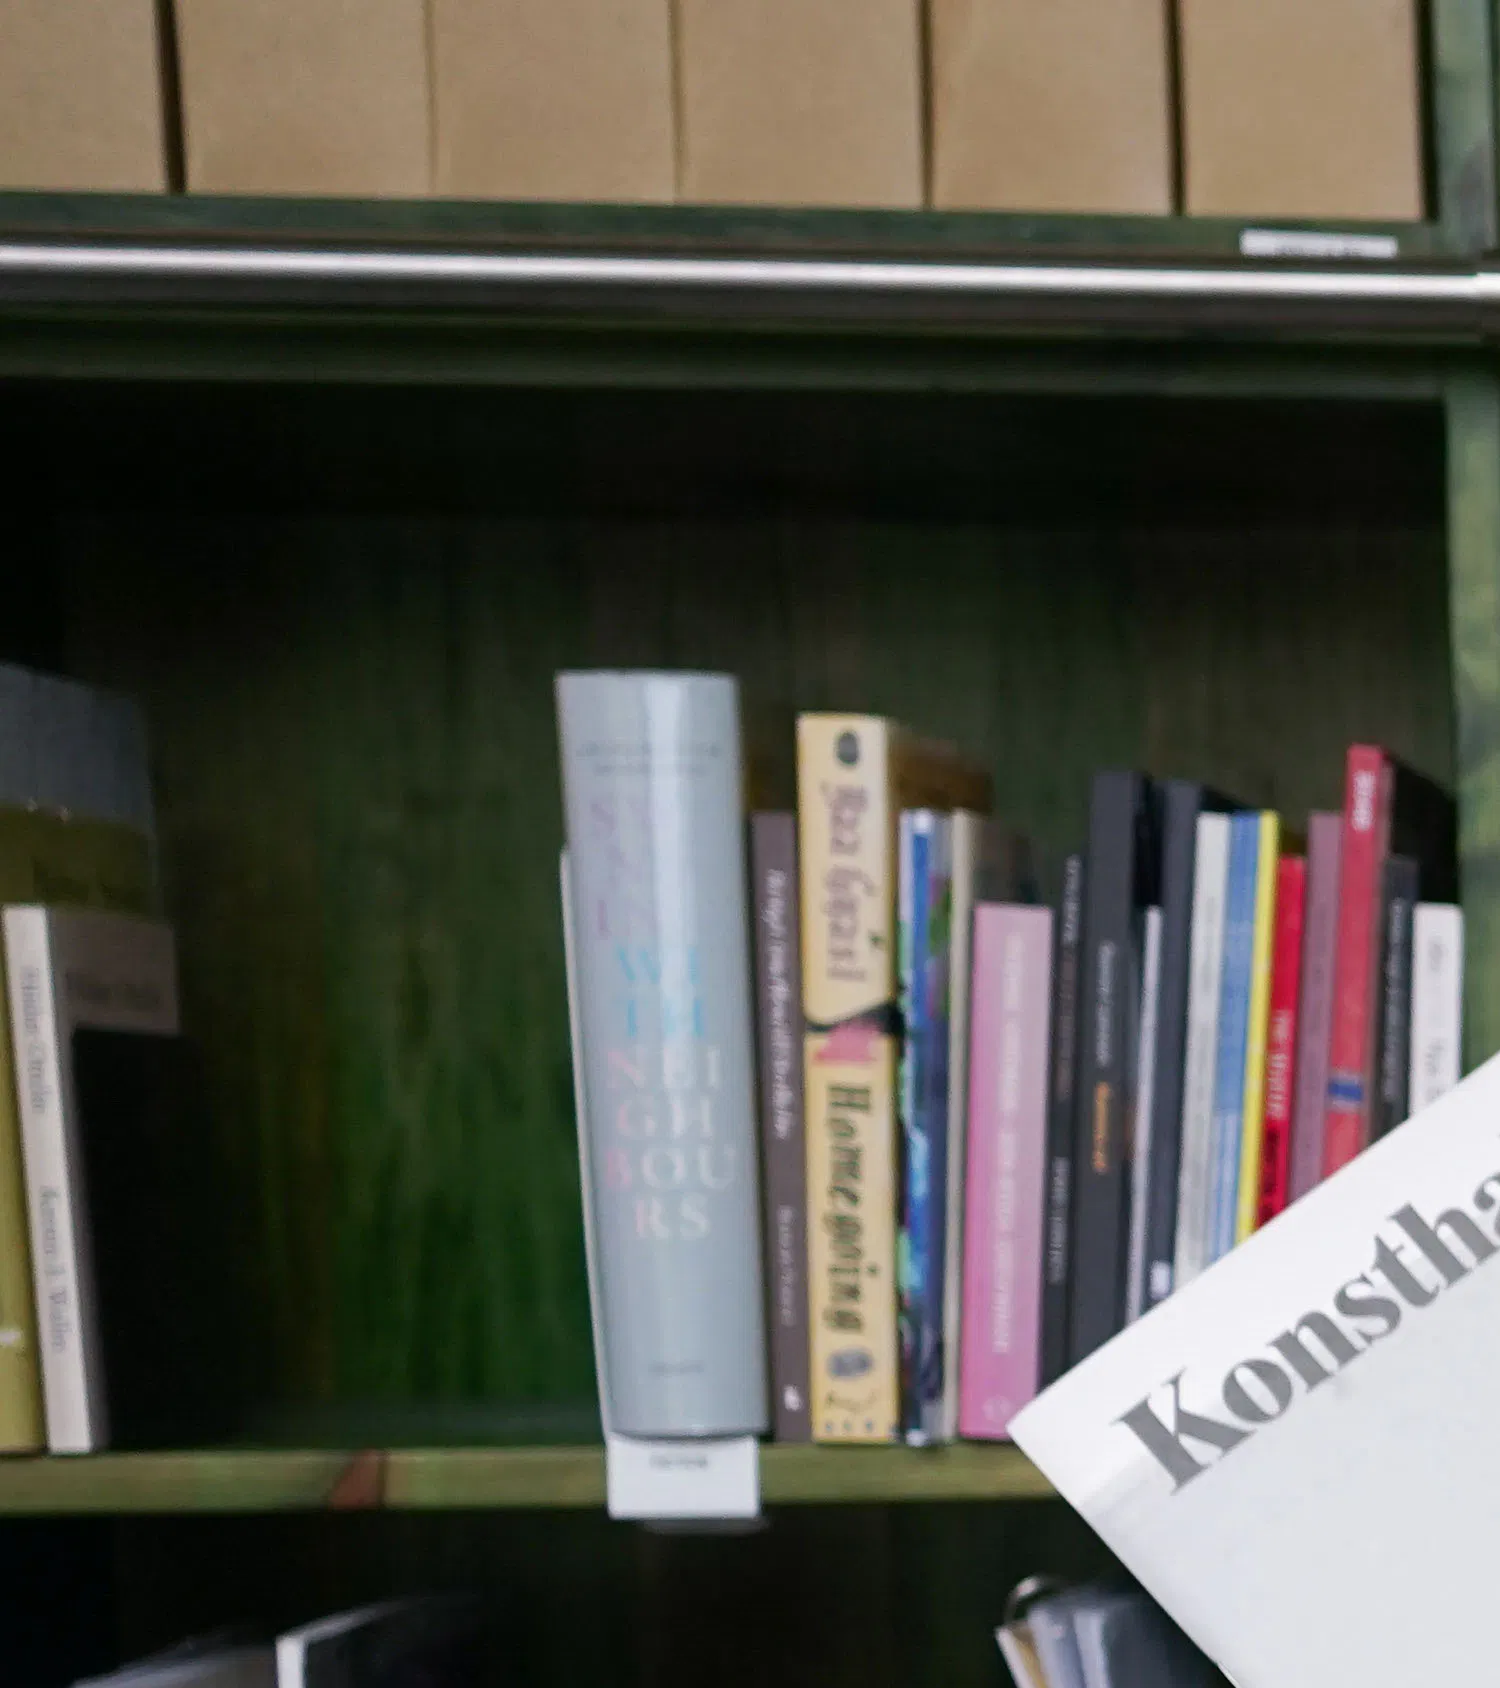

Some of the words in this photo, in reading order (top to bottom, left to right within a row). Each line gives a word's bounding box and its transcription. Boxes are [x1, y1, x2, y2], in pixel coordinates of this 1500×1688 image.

[823, 862, 883, 983] Gyasi
[635, 1195, 713, 1240] RS
[824, 1084, 884, 1337] Homegoing
